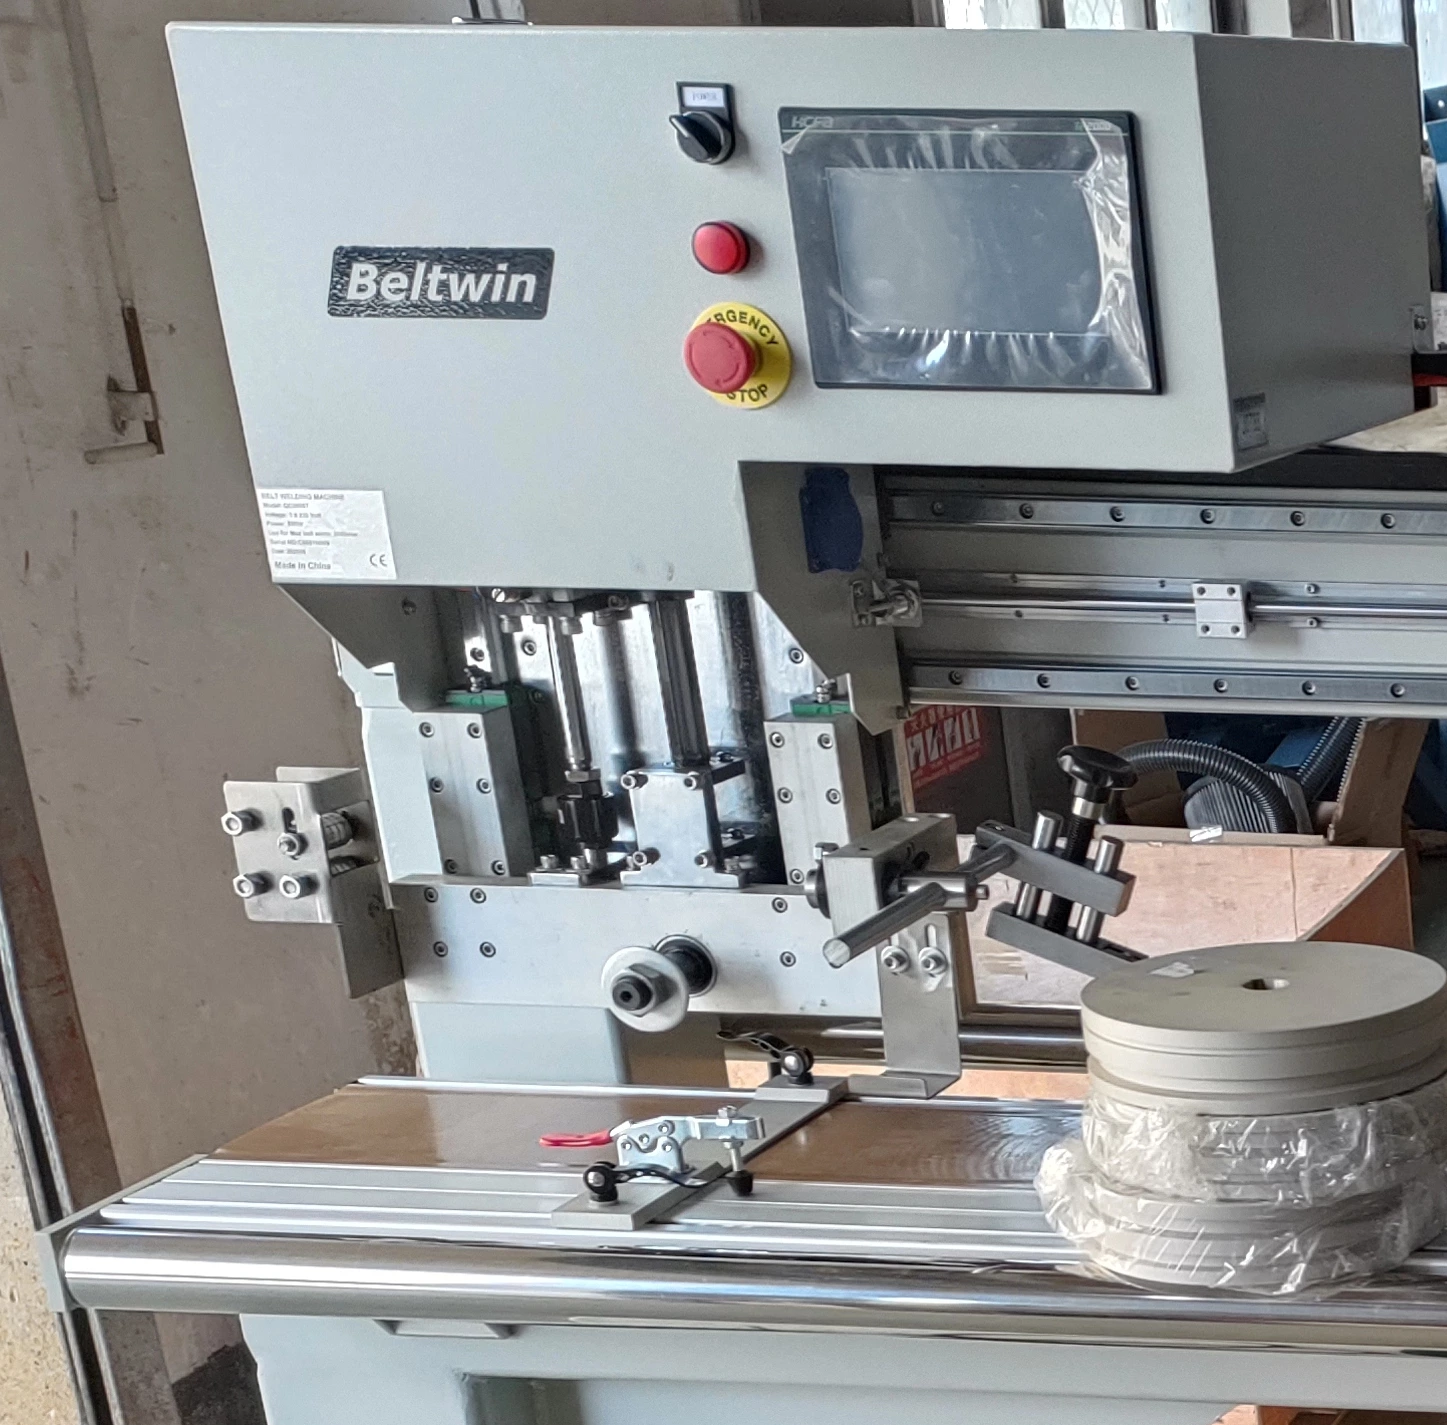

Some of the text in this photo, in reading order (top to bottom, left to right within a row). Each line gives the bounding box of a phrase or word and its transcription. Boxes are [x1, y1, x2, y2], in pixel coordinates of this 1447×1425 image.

[346, 259, 537, 303] Beltwin
[706, 309, 779, 345] RGENCY
[280, 493, 312, 501] WELDING
[274, 561, 296, 569] Made
[307, 562, 332, 570] China
